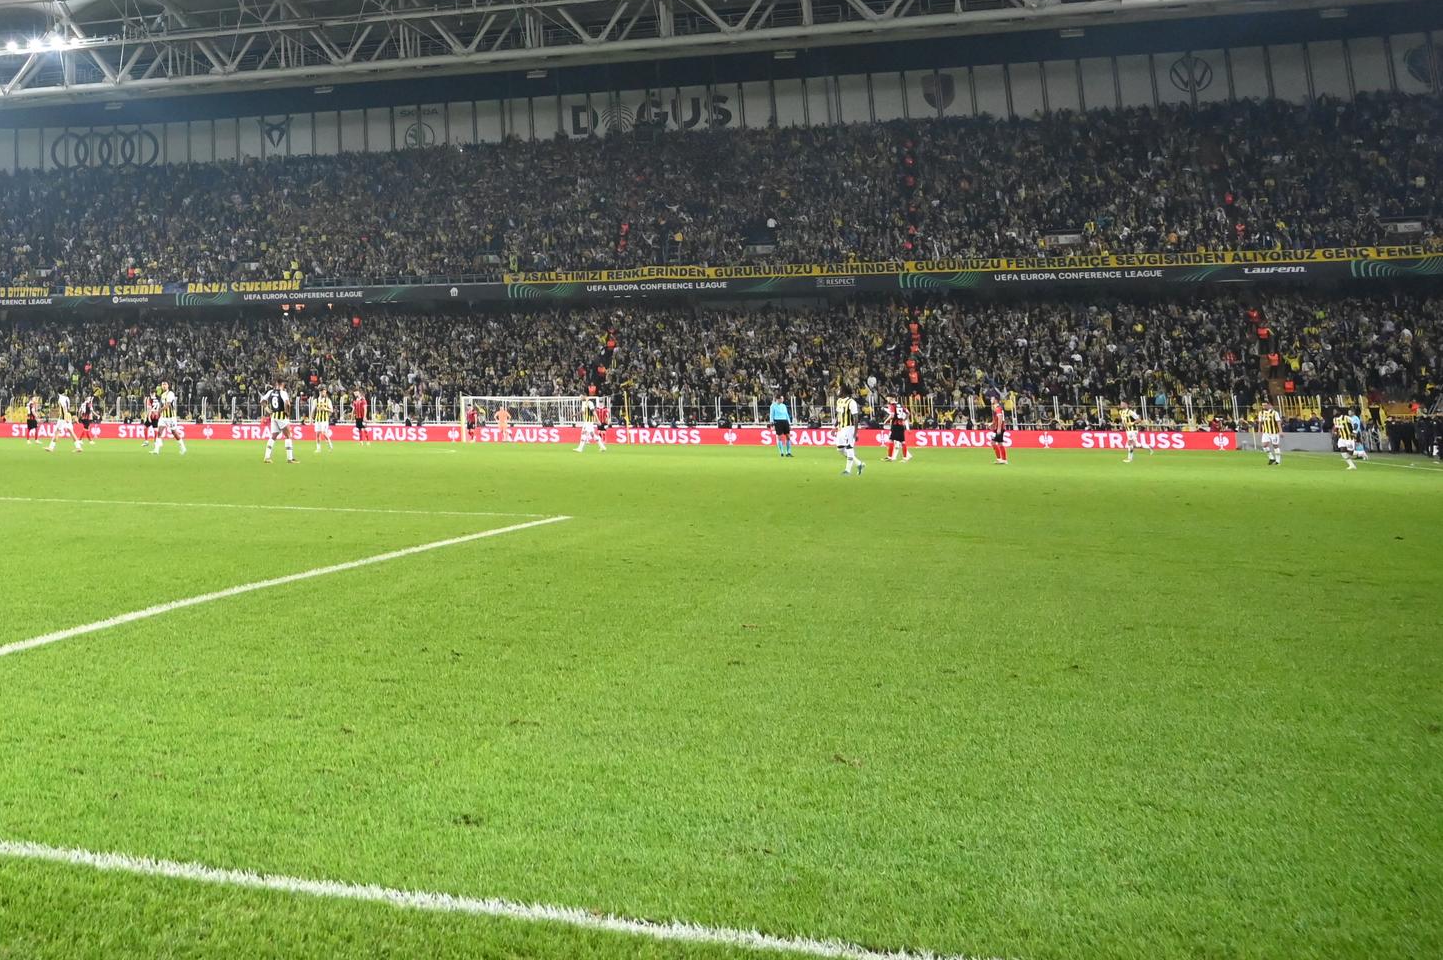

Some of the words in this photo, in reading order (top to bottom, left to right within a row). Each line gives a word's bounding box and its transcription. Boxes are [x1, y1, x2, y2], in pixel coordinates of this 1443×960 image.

[1058, 271, 1122, 280] CONFERENCE
[1125, 270, 1162, 278] LEAGUE
[608, 283, 639, 291] EUROPA
[640, 282, 694, 290] CONFERENCE
[244, 293, 261, 301] UEFA
[616, 429, 701, 444] STRAUSS
